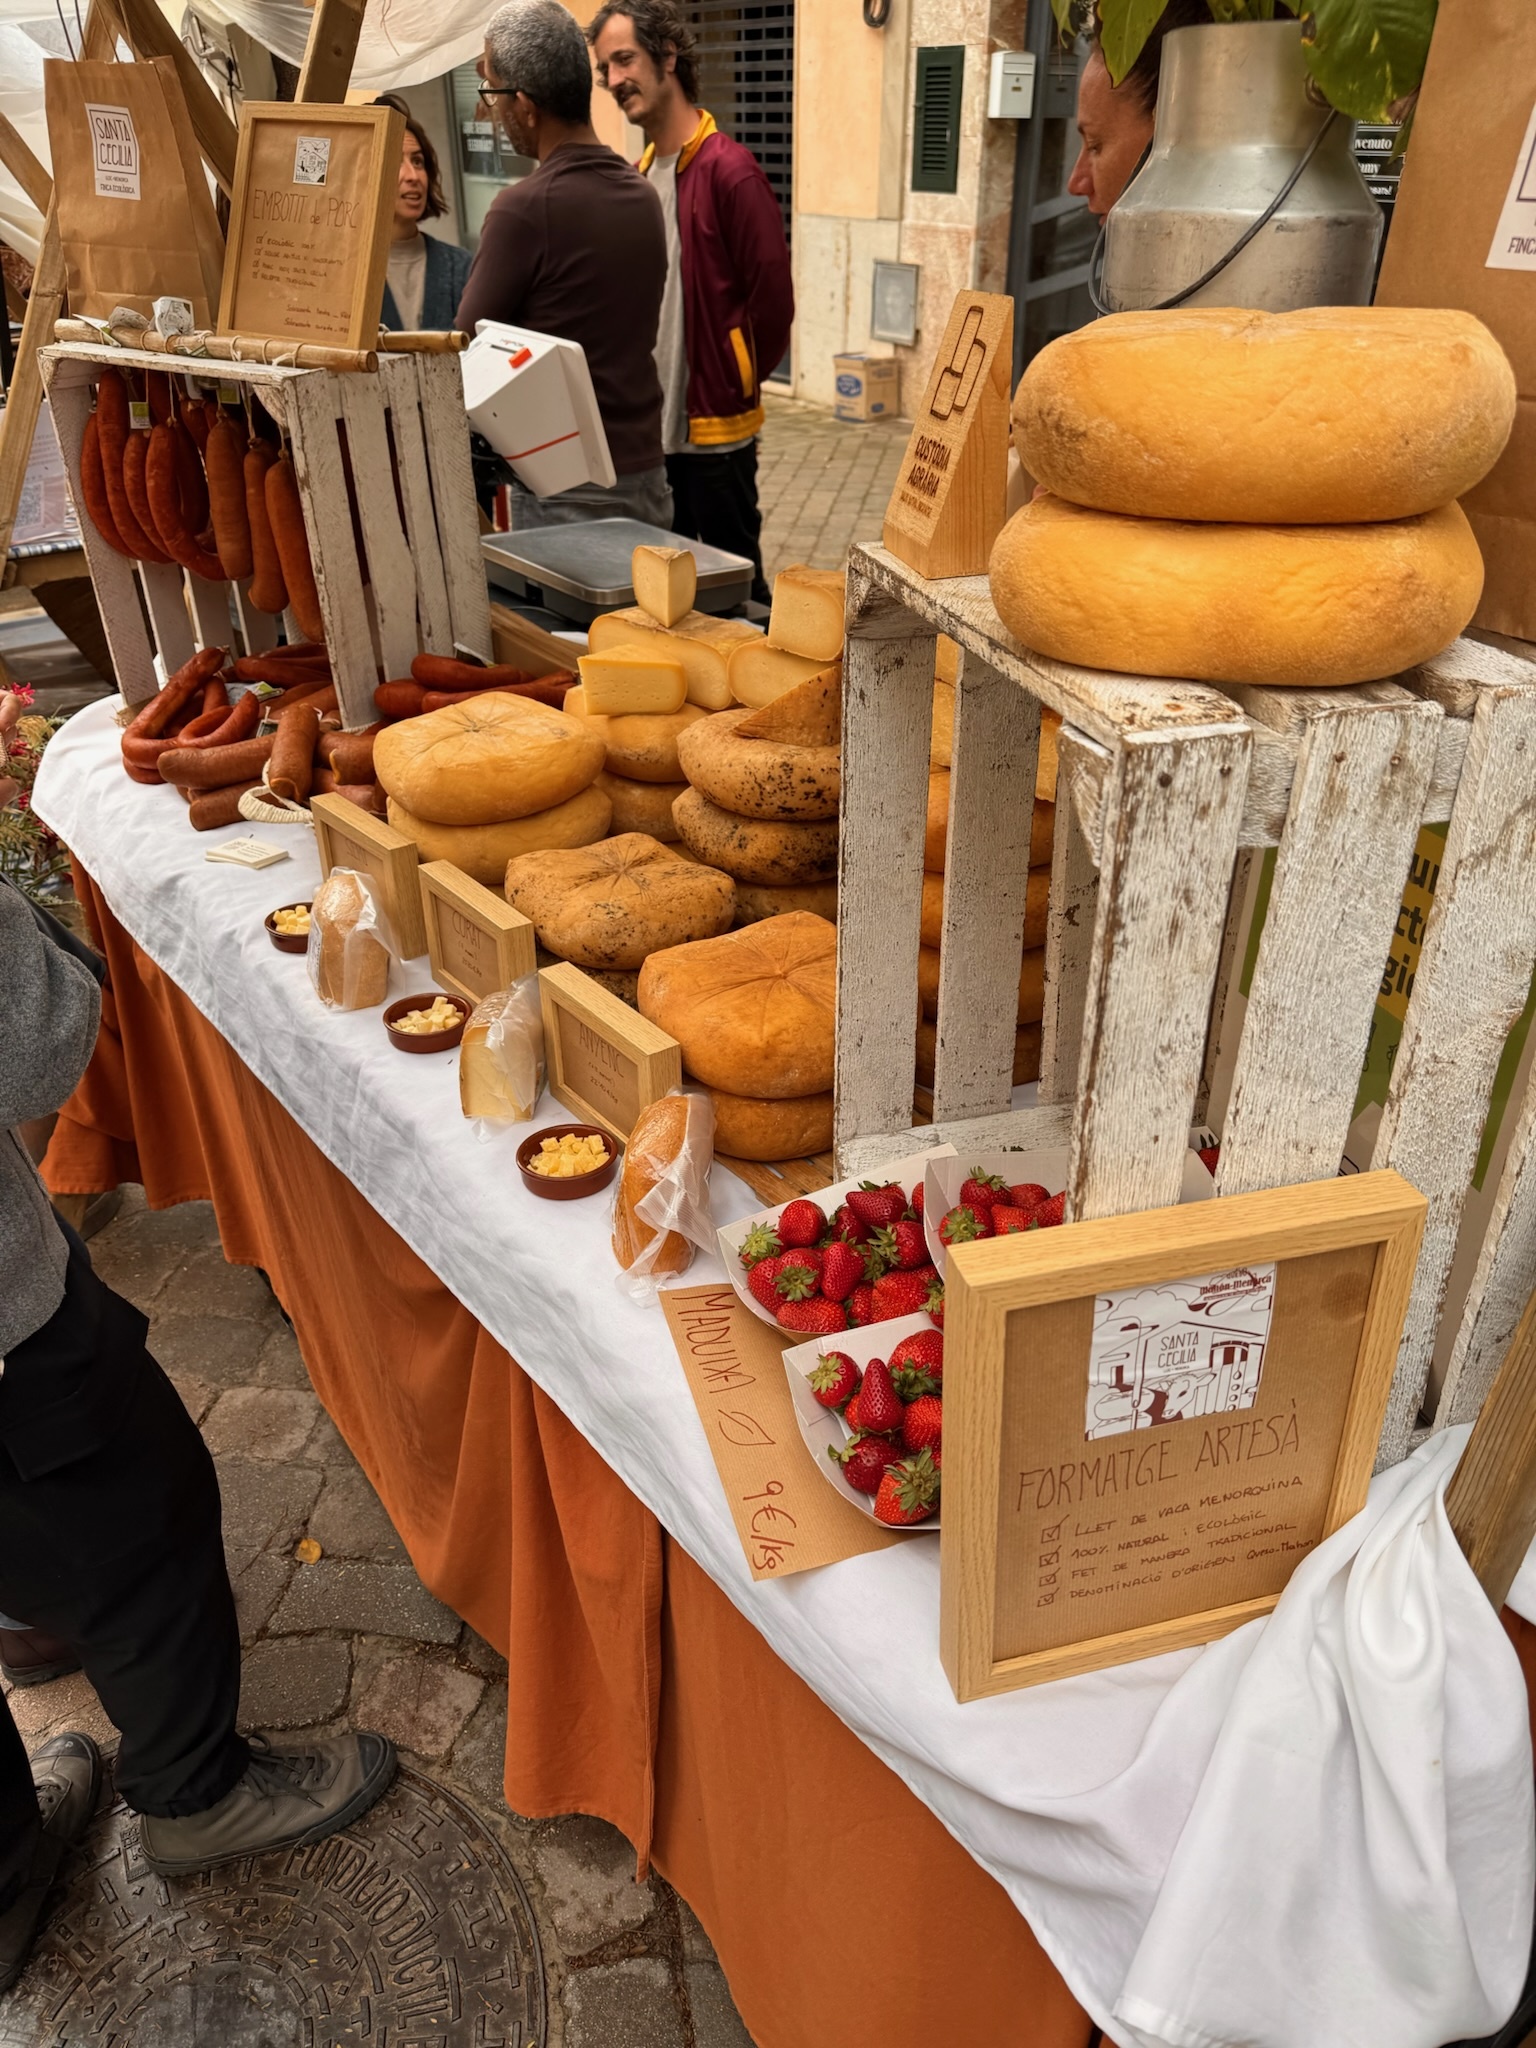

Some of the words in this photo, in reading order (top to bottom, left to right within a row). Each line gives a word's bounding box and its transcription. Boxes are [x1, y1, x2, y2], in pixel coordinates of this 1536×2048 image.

[95, 117, 131, 142] SANTA
[100, 143, 133, 167] CECILIA
[253, 189, 309, 224] EMBOTIT
[310, 200, 321, 225] de
[326, 197, 360, 229] PORC
[671, 1291, 757, 1394] MADUIXA
[1160, 1331, 1200, 1352] SANTA
[1157, 1347, 1197, 1369] CECILIA
[1016, 1439, 1179, 1512] FORMATGE
[1194, 1397, 1301, 1473] ARTESÀ
[1074, 1519, 1118, 1537] LLET
[1130, 1513, 1148, 1526] DE
[1158, 1502, 1191, 1519] VACA
[1070, 1544, 1109, 1560] 100%
[1117, 1532, 1170, 1552] NATURAL
[1071, 1566, 1099, 1580] FET
[1111, 1562, 1129, 1573] DE
[1140, 1547, 1191, 1566] MANERA
